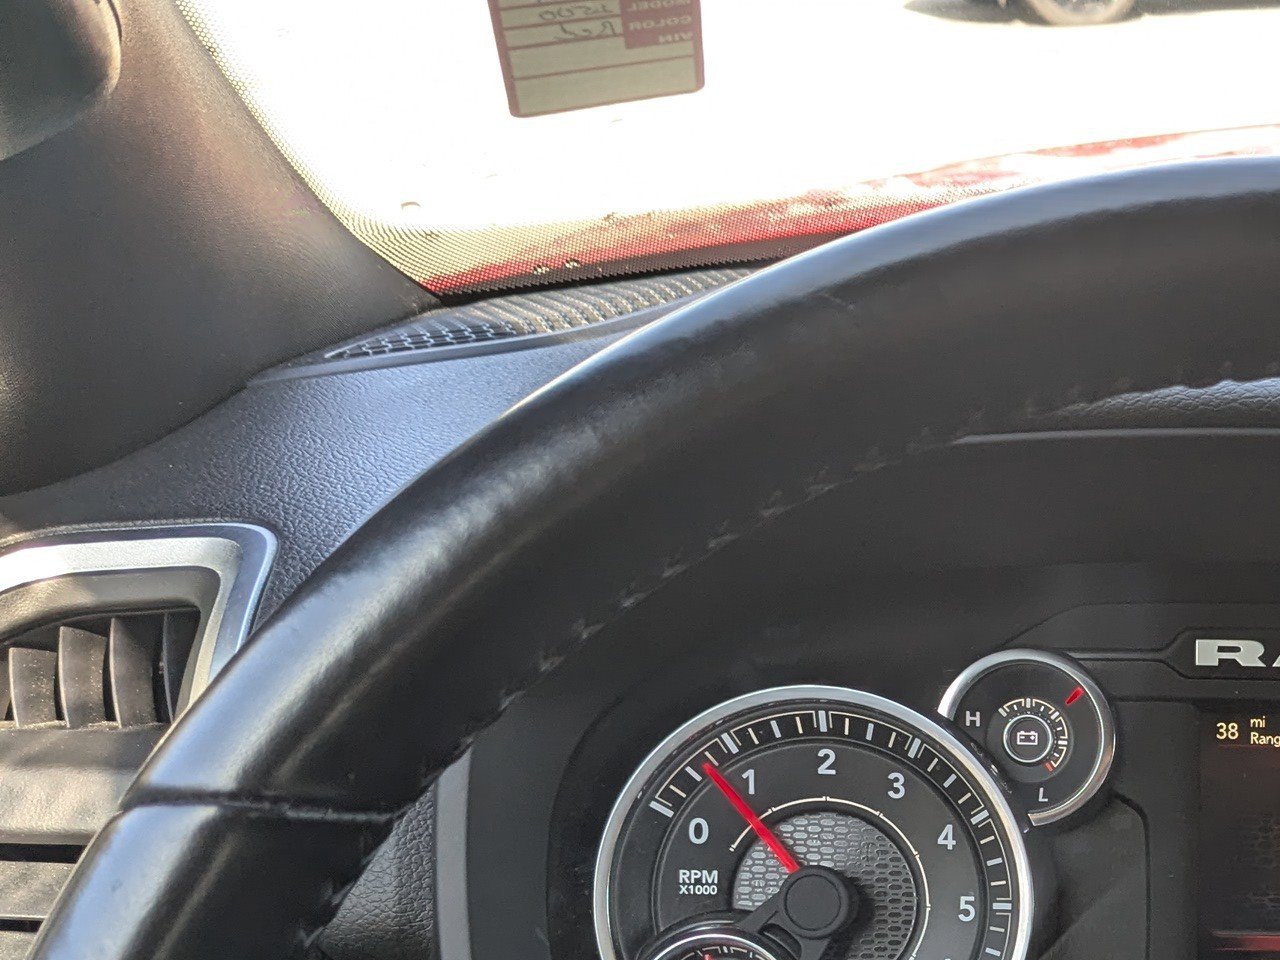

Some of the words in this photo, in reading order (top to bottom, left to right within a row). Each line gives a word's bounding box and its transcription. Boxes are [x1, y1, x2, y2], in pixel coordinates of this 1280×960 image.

[965, 710, 981, 727] H
[1250, 717, 1266, 728] mi
[1216, 722, 1239, 740] 38
[817, 748, 837, 775] 2
[741, 769, 757, 795] 1
[887, 772, 906, 798] 3
[1038, 787, 1049, 802] L
[687, 817, 709, 845] 0
[937, 825, 957, 850] 4
[679, 869, 719, 884] RPM
[679, 884, 718, 895] X1000
[959, 896, 976, 921] 5
